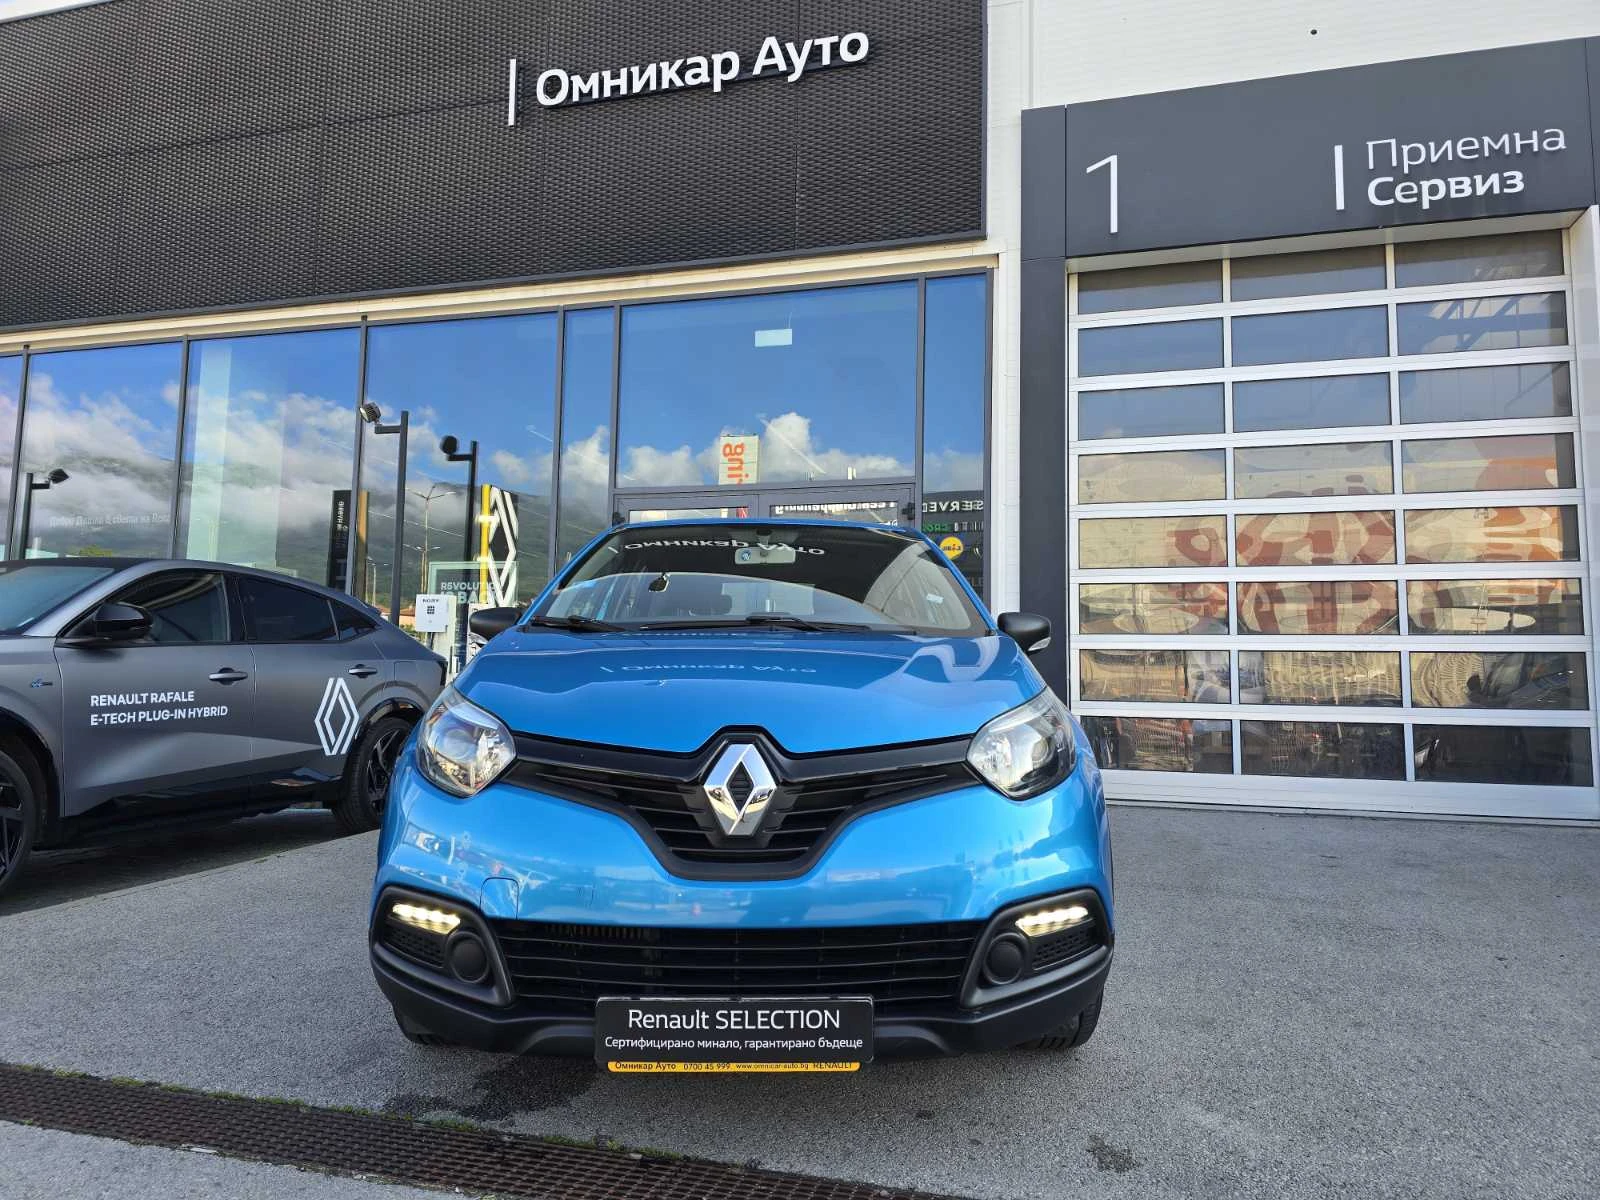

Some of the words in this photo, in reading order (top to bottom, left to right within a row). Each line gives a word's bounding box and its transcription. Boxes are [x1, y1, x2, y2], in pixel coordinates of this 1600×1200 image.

[536, 49, 740, 107] Омникар
[752, 31, 870, 82] Ауто
[1366, 127, 1567, 173] Приемна
[1086, 153, 1118, 233] 1
[1367, 170, 1525, 210] Сервиз
[90, 693, 149, 707] RENAULT
[150, 690, 195, 704] RAFALE
[90, 711, 136, 726] E-TECH
[139, 708, 187, 722] PLUG-IN
[188, 705, 229, 719] HYBRID
[628, 1009, 709, 1030] Renault
[715, 1009, 841, 1030] SELECTION
[605, 1036, 695, 1051] Сертифицирано
[697, 1039, 743, 1051] минало,
[744, 1038, 816, 1051] гарантирано
[818, 1037, 863, 1050] бъдеще
[615, 1061, 653, 1071] Омникар
[656, 1062, 677, 1071] Ауто
[683, 1063, 703, 1071] 0700
[705, 1063, 714, 1071] 45
[717, 1063, 731, 1071] 999
[813, 1061, 853, 1069] RENAULT
